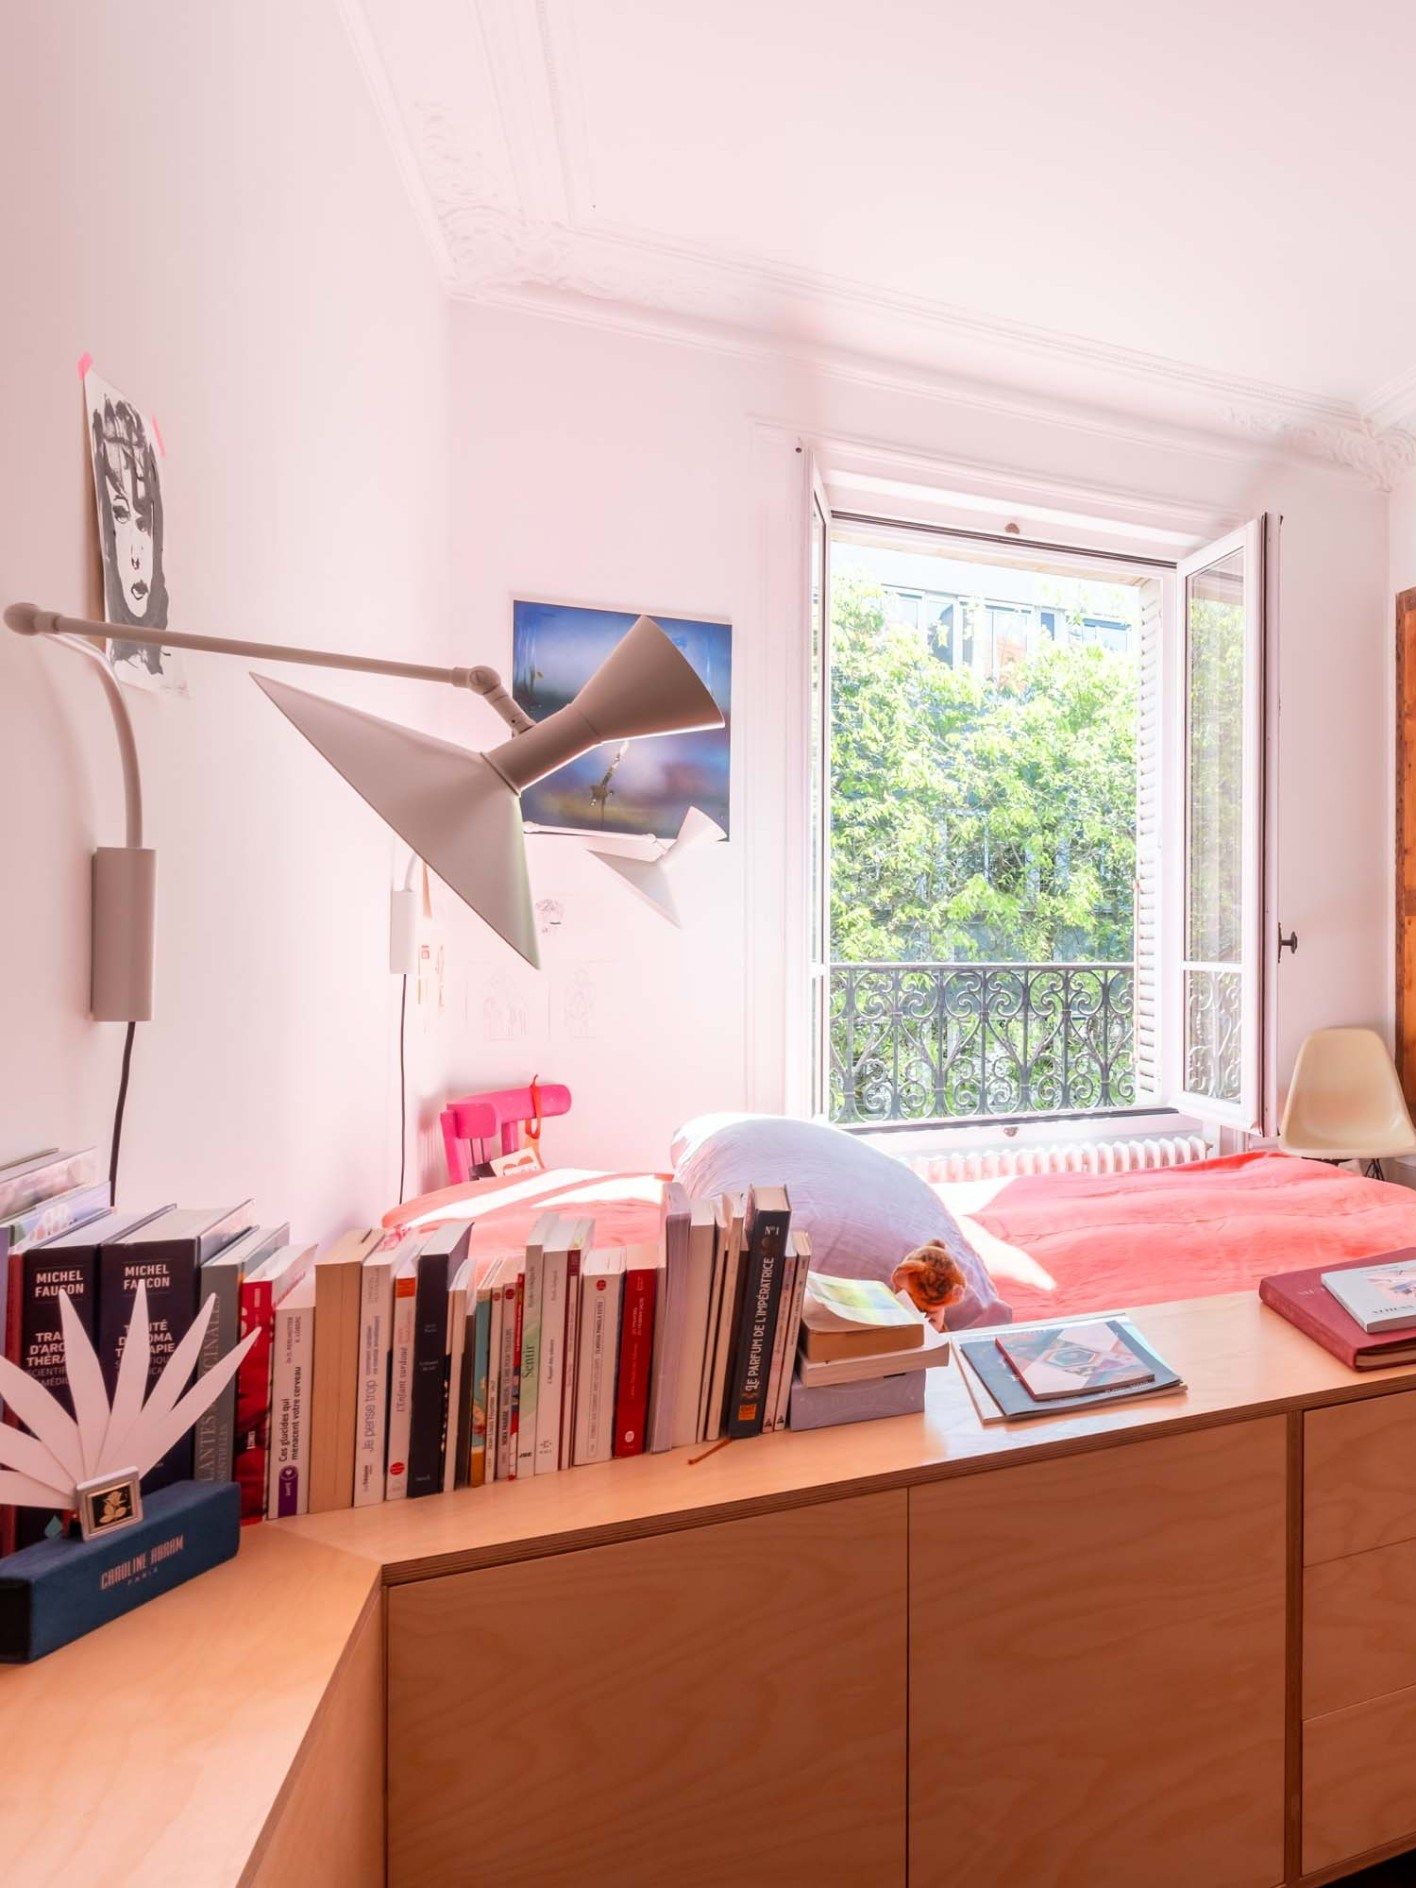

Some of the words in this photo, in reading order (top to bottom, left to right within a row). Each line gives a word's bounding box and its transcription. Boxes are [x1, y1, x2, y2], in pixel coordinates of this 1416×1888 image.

[35, 1269, 84, 1283] MICHEL
[124, 1264, 170, 1277] MICHEL
[123, 1276, 170, 1291] FACON
[754, 1257, 775, 1323] L'IMPÉRATRICE
[753, 1324, 765, 1337] DE
[522, 1344, 536, 1378] Sentir
[747, 1338, 763, 1377] PARFUM
[293, 1367, 302, 1397] cerveau
[364, 1380, 377, 1401] trop
[746, 1378, 760, 1392] LE
[280, 1399, 291, 1412] qui
[292, 1399, 301, 1420] votre
[279, 1413, 290, 1447] glucides
[364, 1404, 376, 1438] pense
[199, 1416, 216, 1481] LANTES
[291, 1422, 300, 1460] menacent
[363, 1439, 375, 1453] Je
[278, 1448, 288, 1462] Ces
